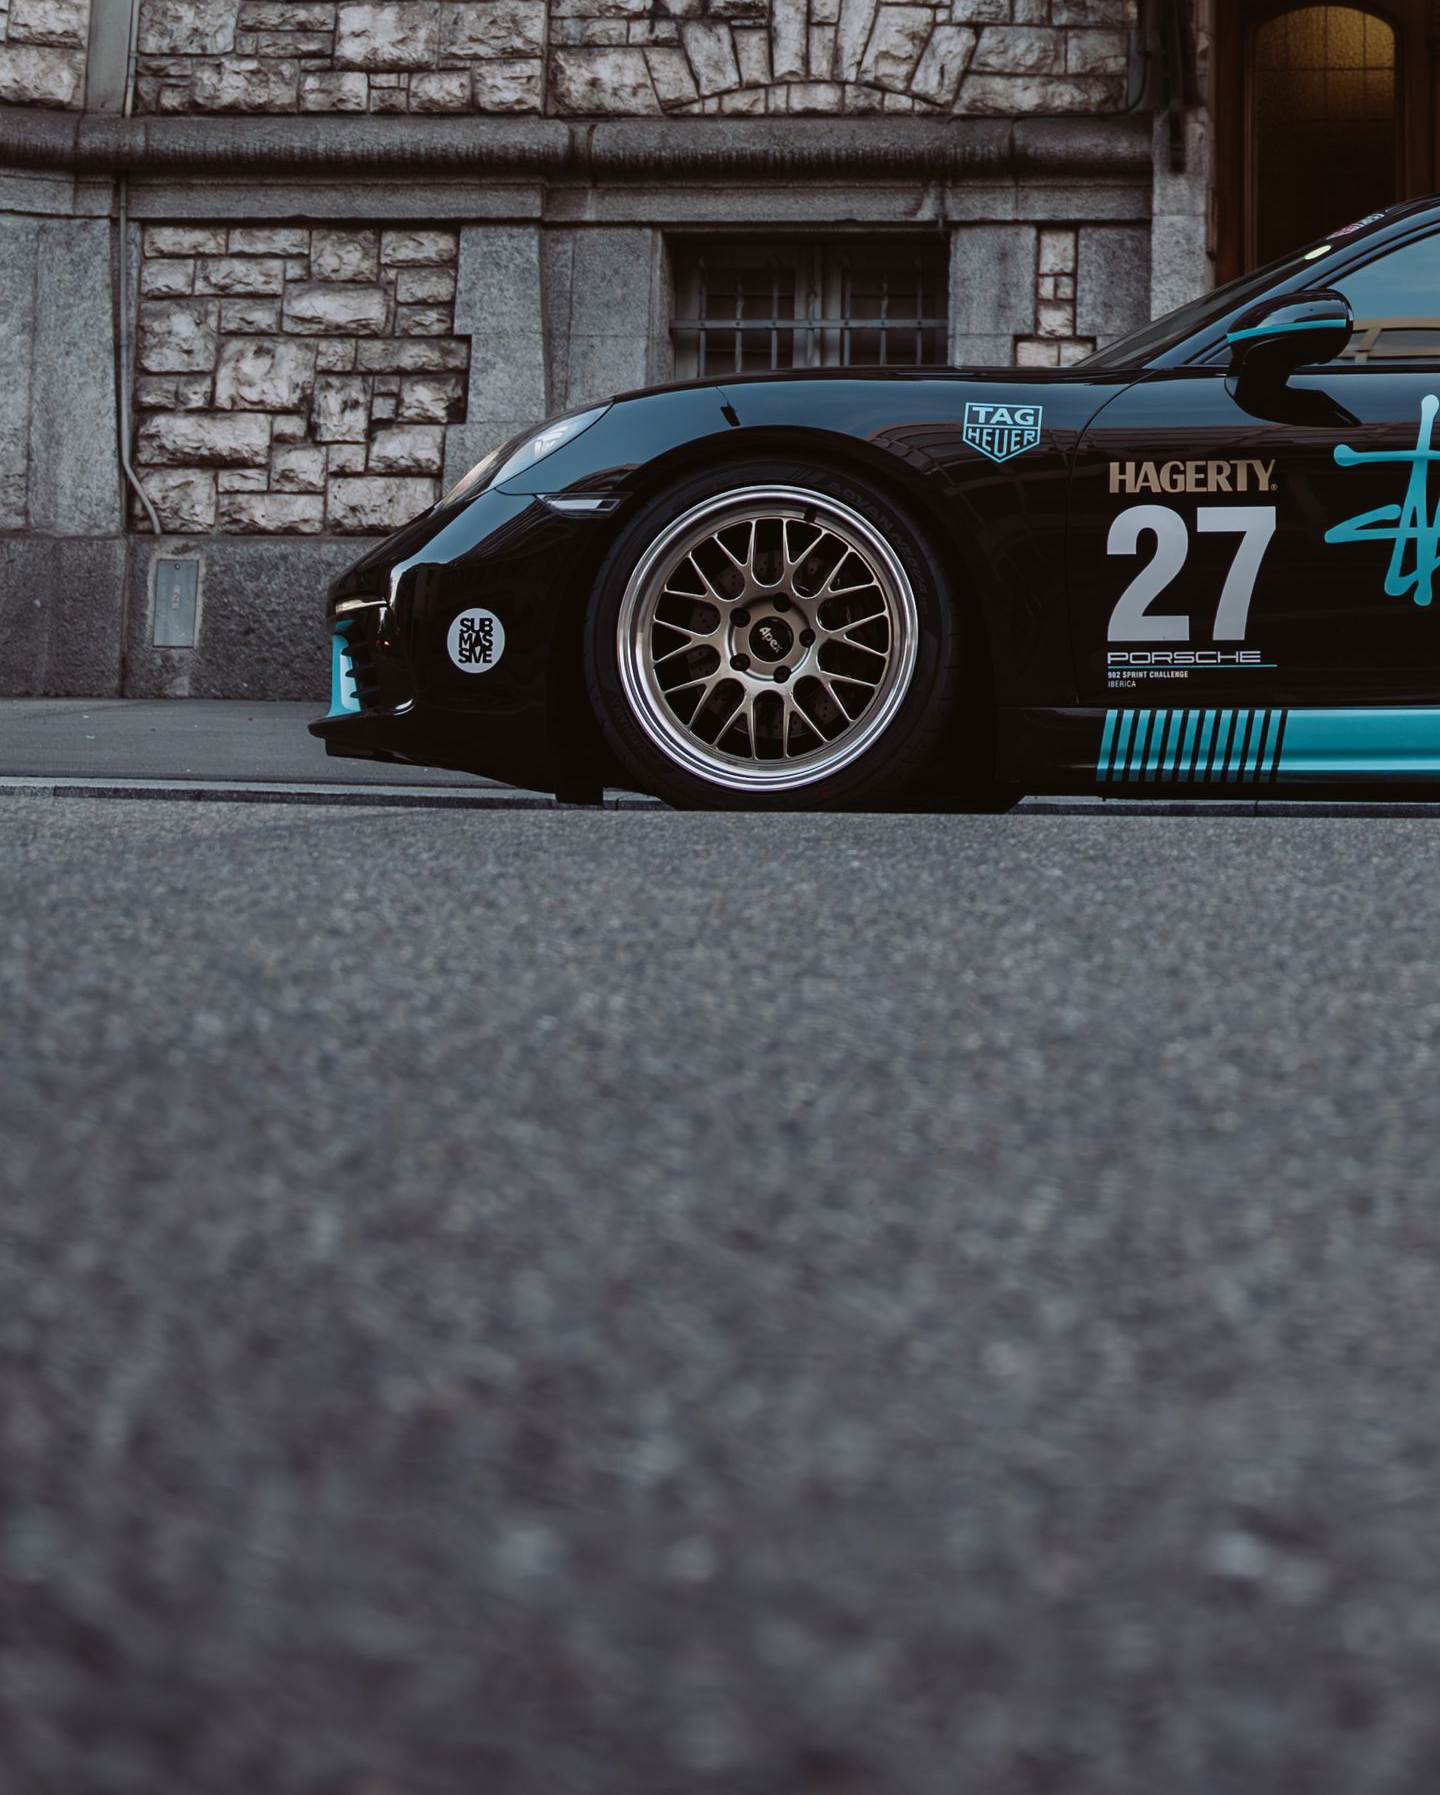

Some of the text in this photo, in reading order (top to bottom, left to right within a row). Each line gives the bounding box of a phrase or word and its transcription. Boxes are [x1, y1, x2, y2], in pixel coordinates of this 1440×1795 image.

[972, 406, 1035, 426] TAG
[967, 427, 1037, 458] HEUER
[1106, 504, 1276, 642] 27
[459, 617, 494, 634] SUB
[458, 632, 494, 649] MAS
[758, 626, 784, 654] Apex
[458, 647, 493, 664] SIVE
[1107, 650, 1262, 664] PORSCHE
[1122, 671, 1148, 679] SPRINT
[1149, 670, 1189, 679] CHALLENGE
[1107, 680, 1137, 688] IBERICA
